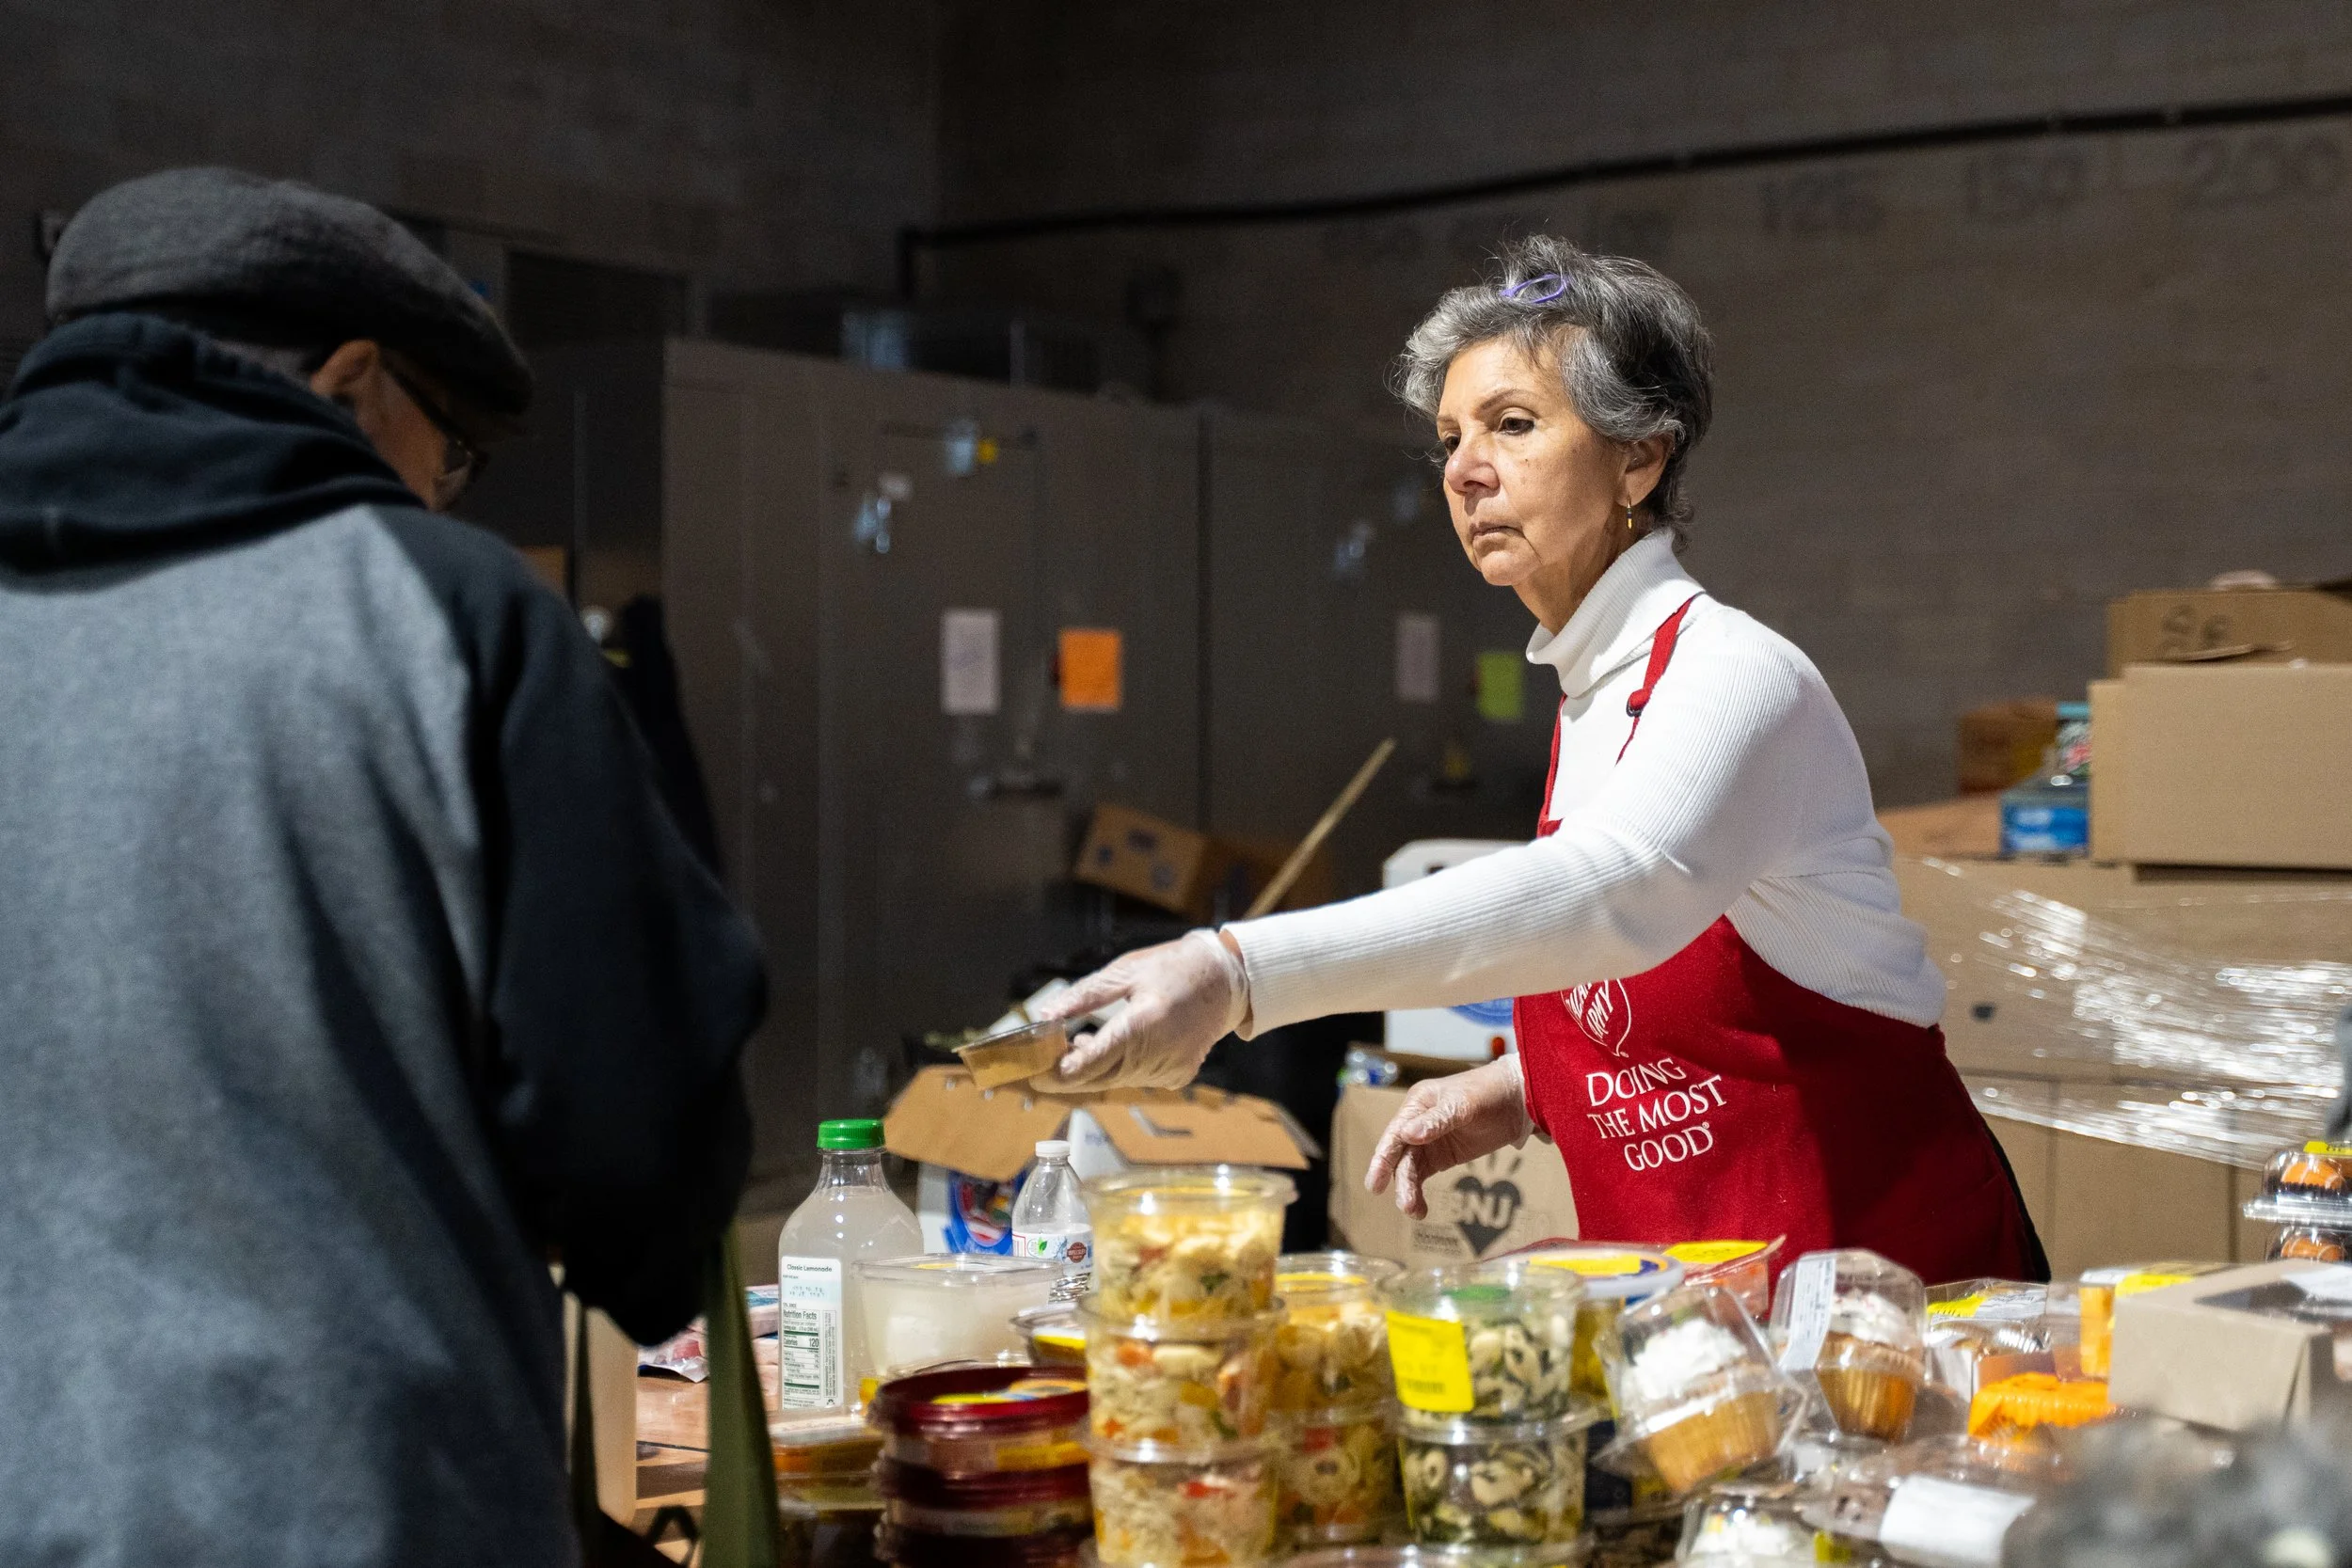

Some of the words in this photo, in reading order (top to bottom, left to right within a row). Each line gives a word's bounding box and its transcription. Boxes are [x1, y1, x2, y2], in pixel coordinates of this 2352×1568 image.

[1585, 1058, 1686, 1106] DOING
[1587, 1108, 1635, 1139] THE
[1638, 1075, 1727, 1132] MOST
[1624, 1125, 1714, 1171] GOOD
[783, 1309, 802, 1319] Nutrition
[803, 1311, 818, 1320] Facts
[809, 1338, 819, 1347] 120
